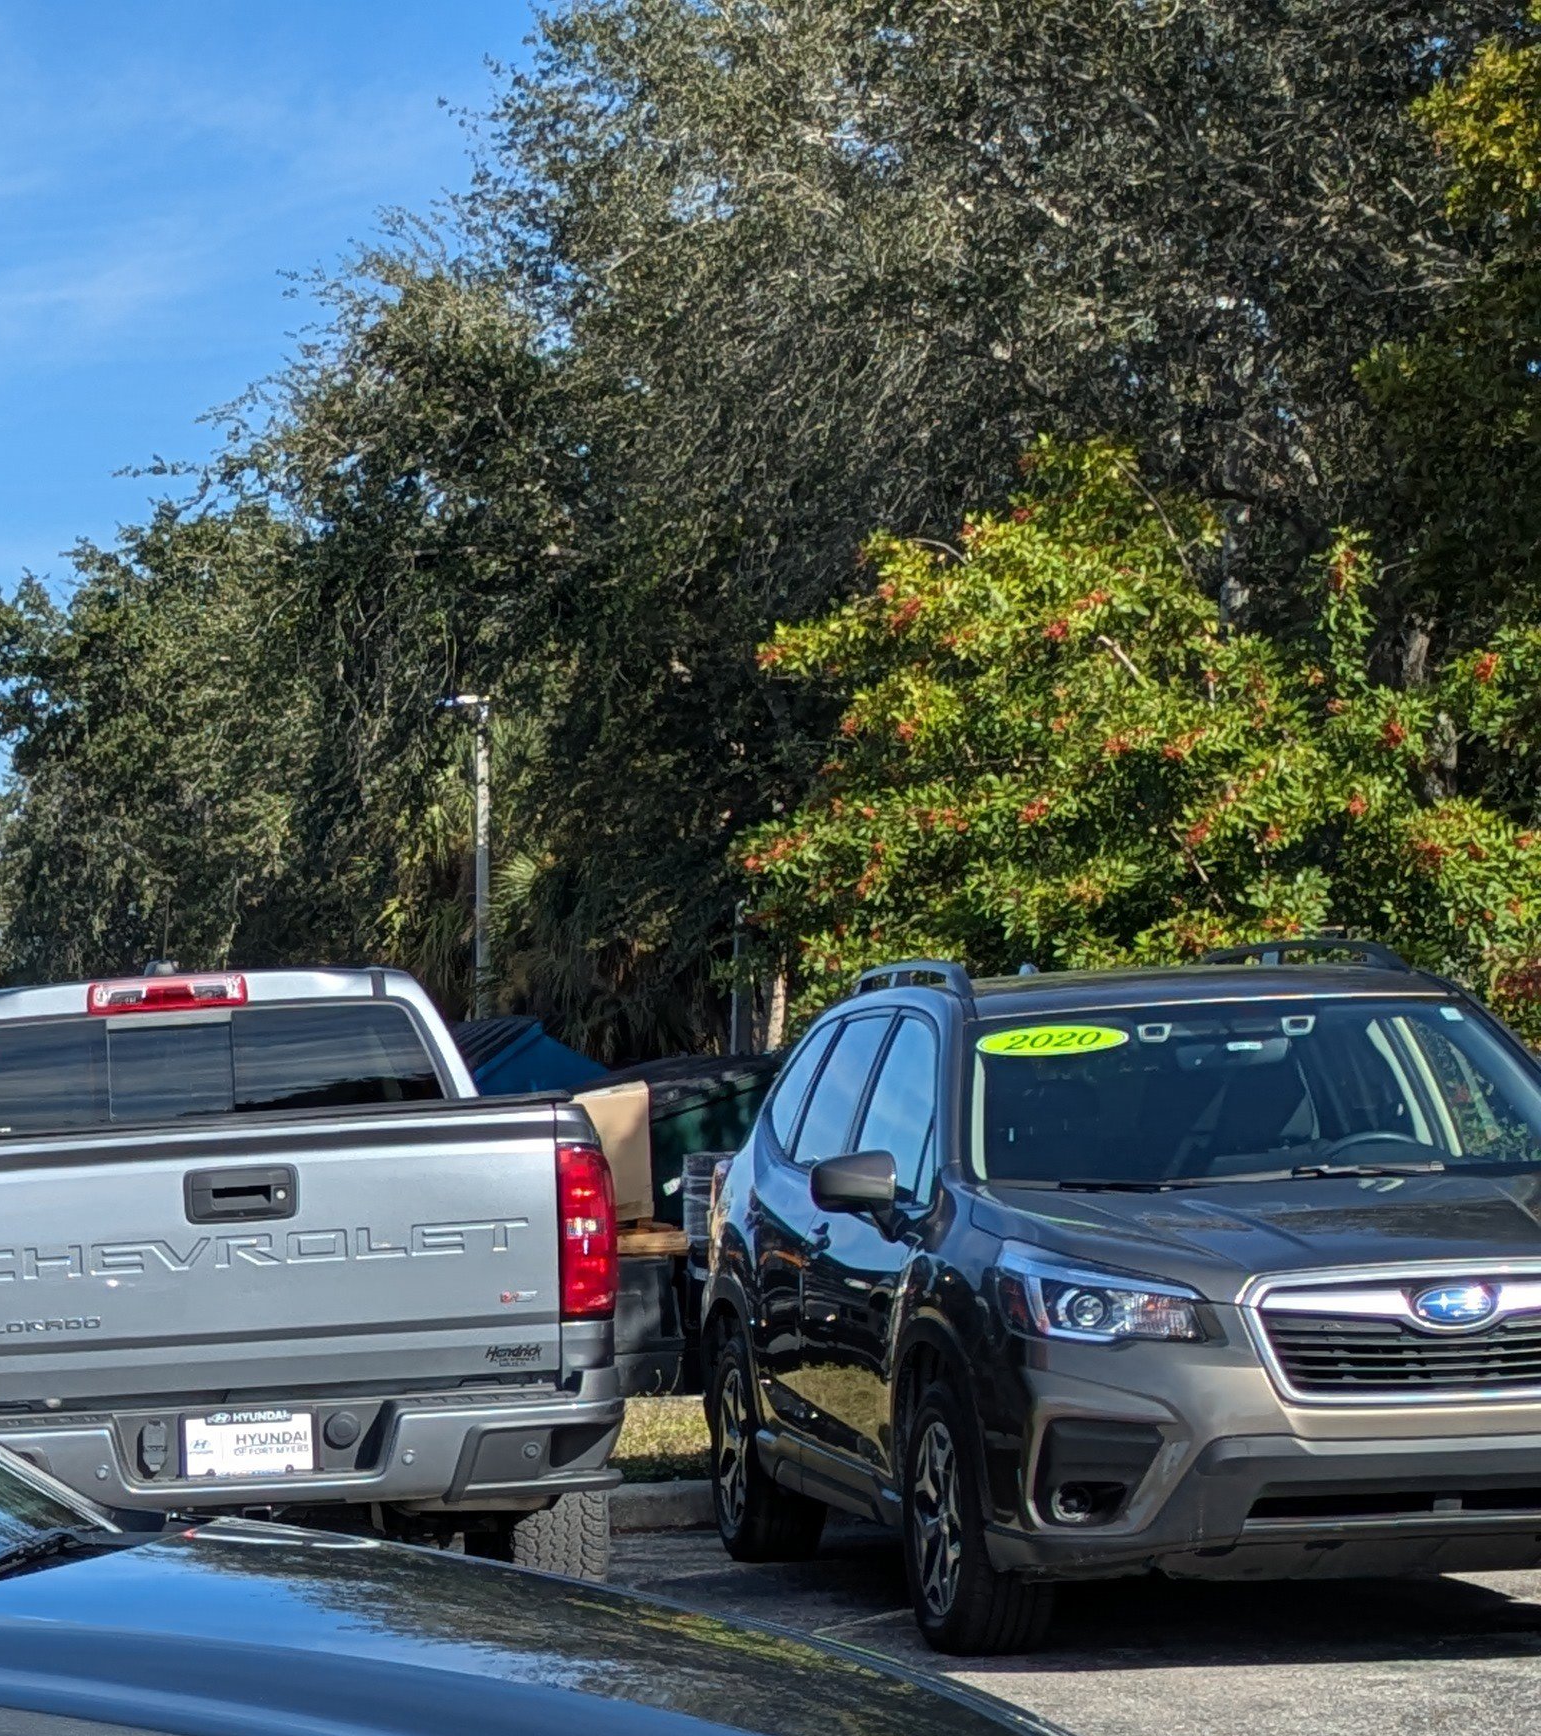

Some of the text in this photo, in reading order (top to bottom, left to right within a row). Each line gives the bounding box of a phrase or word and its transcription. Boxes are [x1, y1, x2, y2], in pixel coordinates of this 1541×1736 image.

[1004, 1031, 1102, 1050] 2020
[233, 1410, 288, 1422] HYUNDAI
[236, 1431, 307, 1445] HYUNDAI
[248, 1446, 274, 1455] FORT
